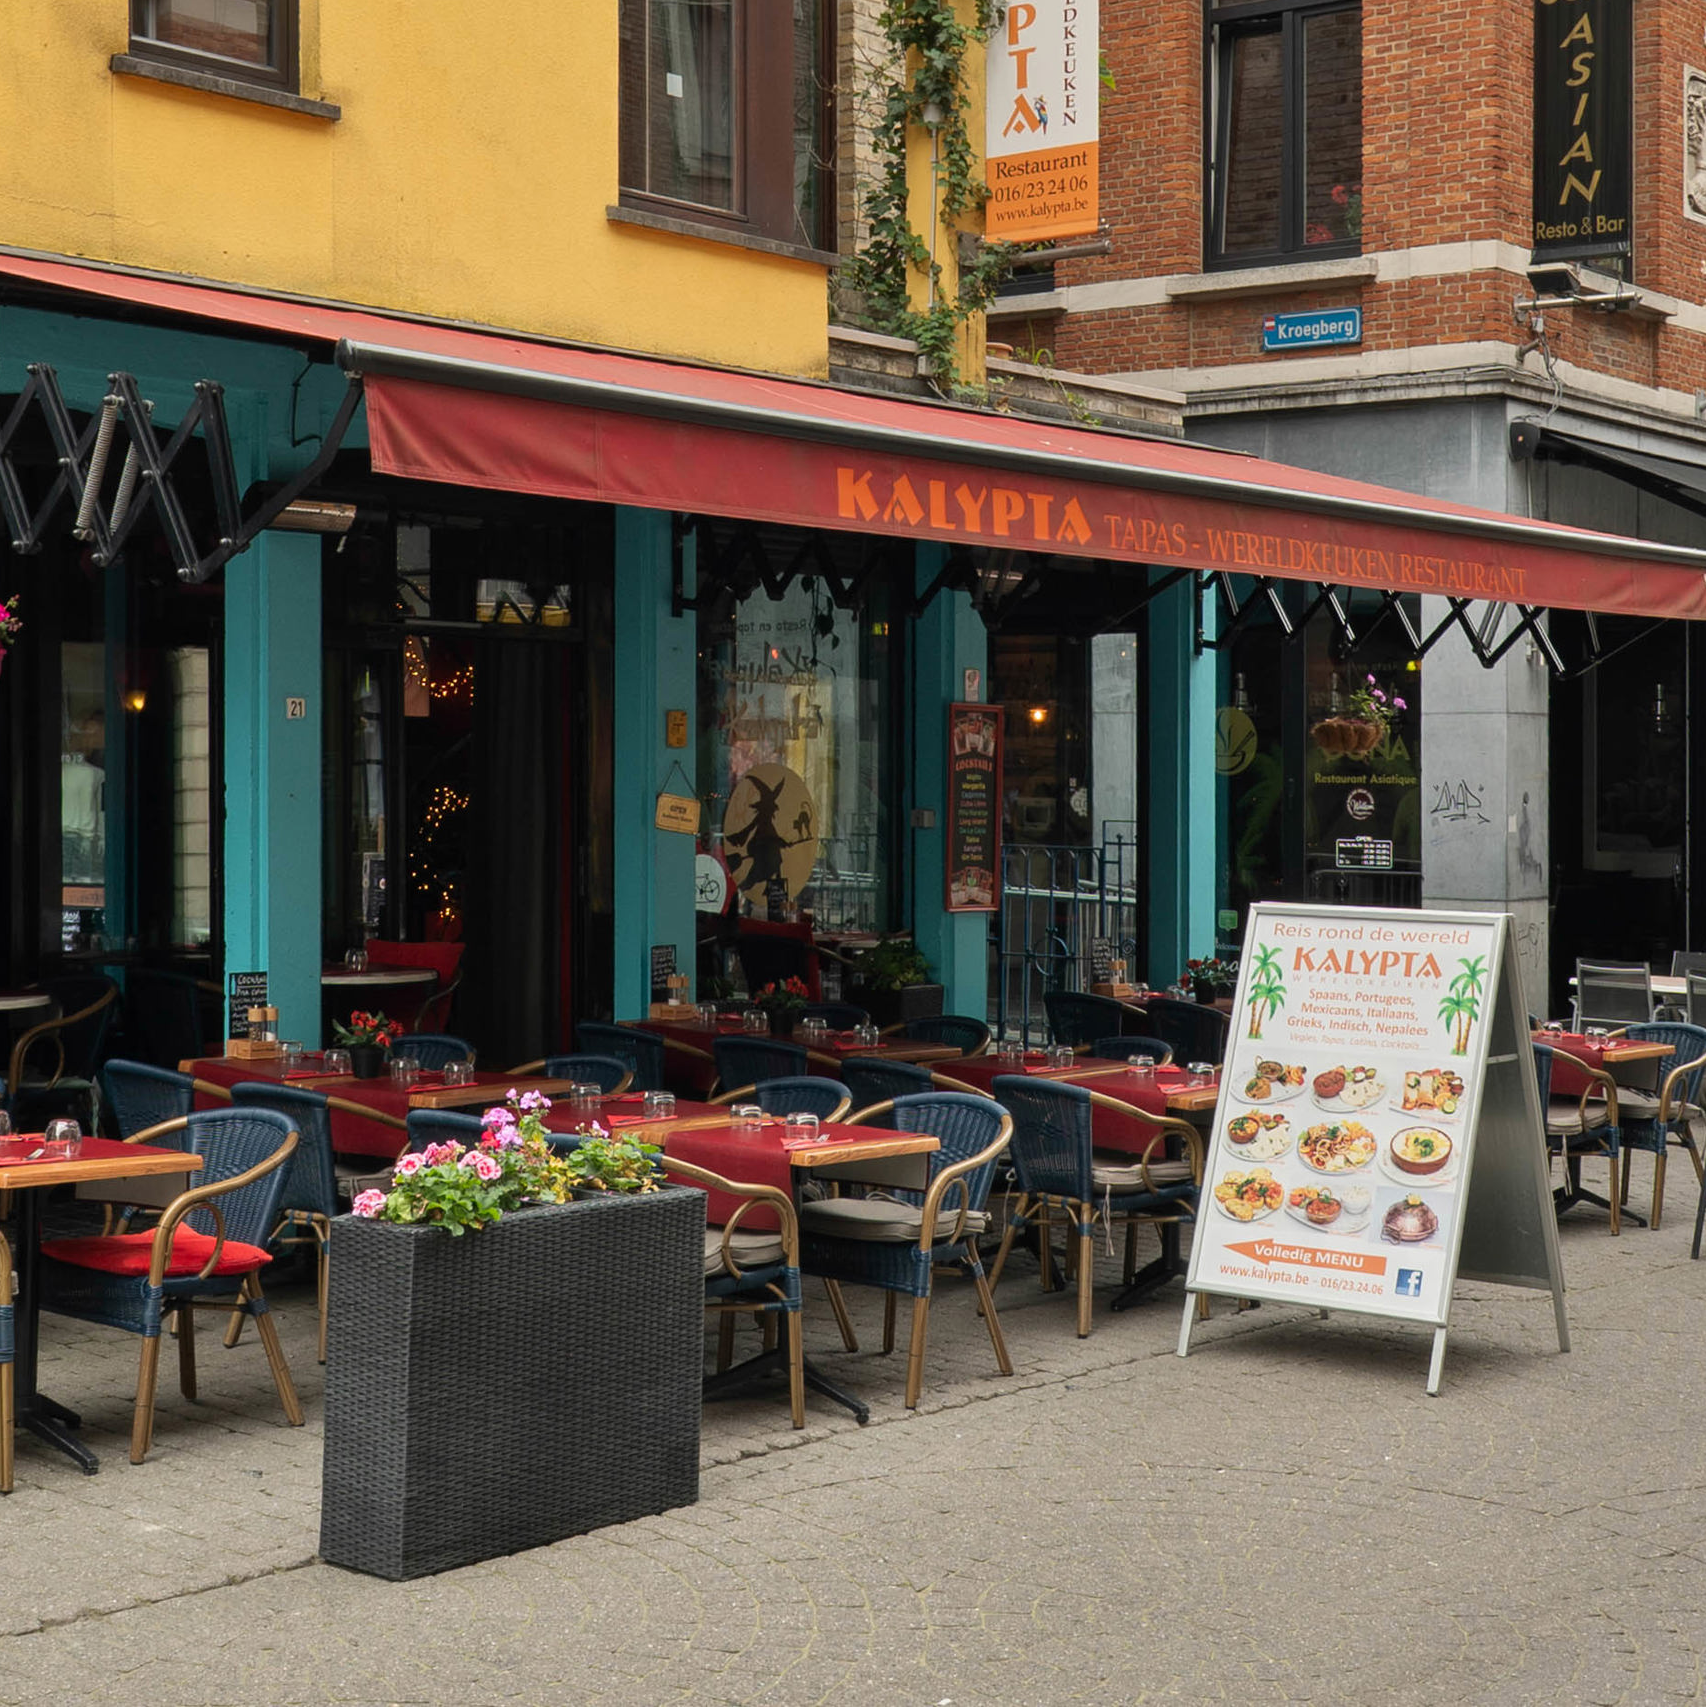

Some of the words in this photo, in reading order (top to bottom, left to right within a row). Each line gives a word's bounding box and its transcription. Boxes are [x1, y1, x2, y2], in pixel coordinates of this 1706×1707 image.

[1557, 11, 1603, 208] ASIAN
[995, 150, 1089, 180] Restaurant
[994, 180, 1045, 204] 016/23
[1047, 177, 1066, 196] 24
[1069, 174, 1089, 192] 06
[995, 197, 1089, 222] www.kalypta.be
[1536, 219, 1577, 243] Resto
[1579, 216, 1594, 237] &
[1596, 212, 1627, 236] Bar
[1277, 319, 1354, 341] Kroegberg
[835, 466, 1093, 547] KALYPTA
[1103, 514, 1187, 557] TAPAS
[1206, 527, 1394, 583] WERELDKEUKEN
[1399, 552, 1527, 596] RESTAURANT
[290, 700, 303, 718] 21
[1315, 772, 1367, 785] Restaurant
[1370, 773, 1418, 788] Asiatique
[1273, 921, 1312, 939] Reis
[1317, 925, 1365, 941] rond
[1369, 927, 1395, 943] de
[1400, 930, 1470, 945] wereld
[1292, 945, 1443, 980] KALYPTA
[1308, 988, 1353, 1003] Spaans,
[1355, 990, 1416, 1007] Portugees,
[1301, 1002, 1364, 1019] Mexicaans,
[1367, 1007, 1420, 1023] Italiaans,
[1287, 1015, 1326, 1031] Grieks,
[1328, 1019, 1373, 1035] Indisch,
[1375, 1021, 1429, 1037] Nepalees
[1253, 1242, 1313, 1264] Volledig
[1315, 1254, 1365, 1269] MENU
[1219, 1261, 1310, 1286] www.kalypta.be
[1319, 1277, 1384, 1296] 016/23.24.06
